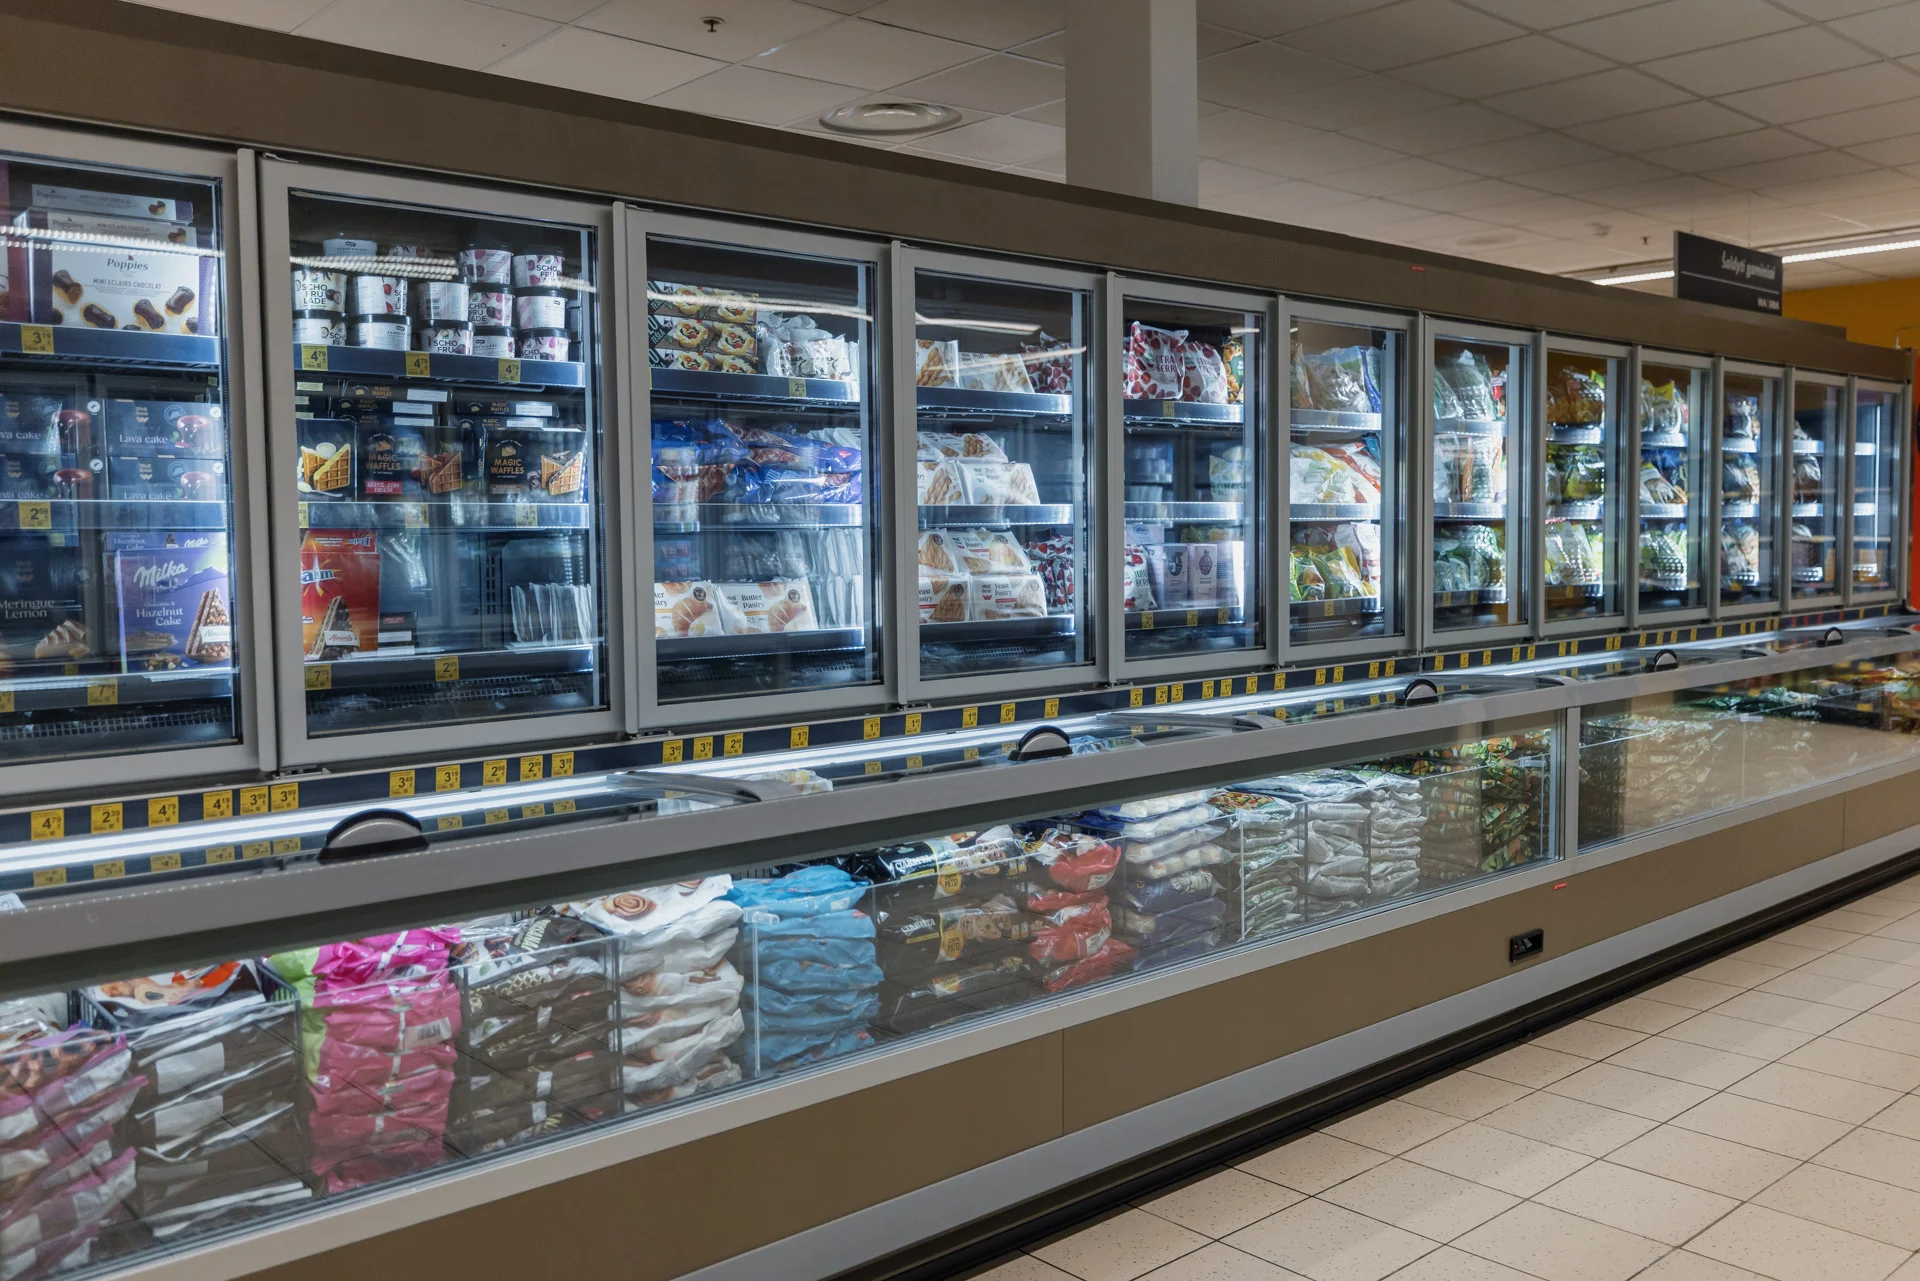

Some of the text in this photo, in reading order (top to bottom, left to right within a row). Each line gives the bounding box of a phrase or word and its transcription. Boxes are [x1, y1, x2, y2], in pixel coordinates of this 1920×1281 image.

[107, 258, 149, 271] Poppies
[93, 278, 162, 290] MINI ECLAIRS CHOCOLAT
[301, 283, 328, 291] SCHO
[305, 290, 324, 298] FRU
[303, 297, 327, 305] LADE
[434, 339, 458, 347] SCHO
[311, 351, 326, 362] 479
[414, 358, 428, 369] 479
[505, 364, 519, 375] 479
[16, 431, 42, 440] cake
[119, 434, 169, 444] Lava cake
[368, 453, 397, 462] MAGIC
[494, 459, 522, 467] MAGIC
[365, 462, 401, 471] WAFFLES
[490, 466, 525, 475] WAFFLES
[17, 491, 44, 500] cake
[123, 491, 172, 500] Lava cake
[114, 537, 209, 548] Hazelnut Milka
[133, 560, 189, 588] Milka
[743, 601, 765, 609] Pastry
[5, 609, 48, 619] Lemon
[136, 607, 184, 618] Hazelnut
[155, 616, 182, 626] Cake
[491, 765, 505, 777] 299
[527, 761, 541, 773] 299
[398, 775, 414, 788] 349
[444, 770, 459, 783] 319
[249, 793, 267, 806] 399
[280, 789, 297, 802] 399
[213, 797, 230, 810] 419
[158, 803, 176, 816] 479
[102, 810, 120, 824] 239
[42, 817, 62, 830] 479
